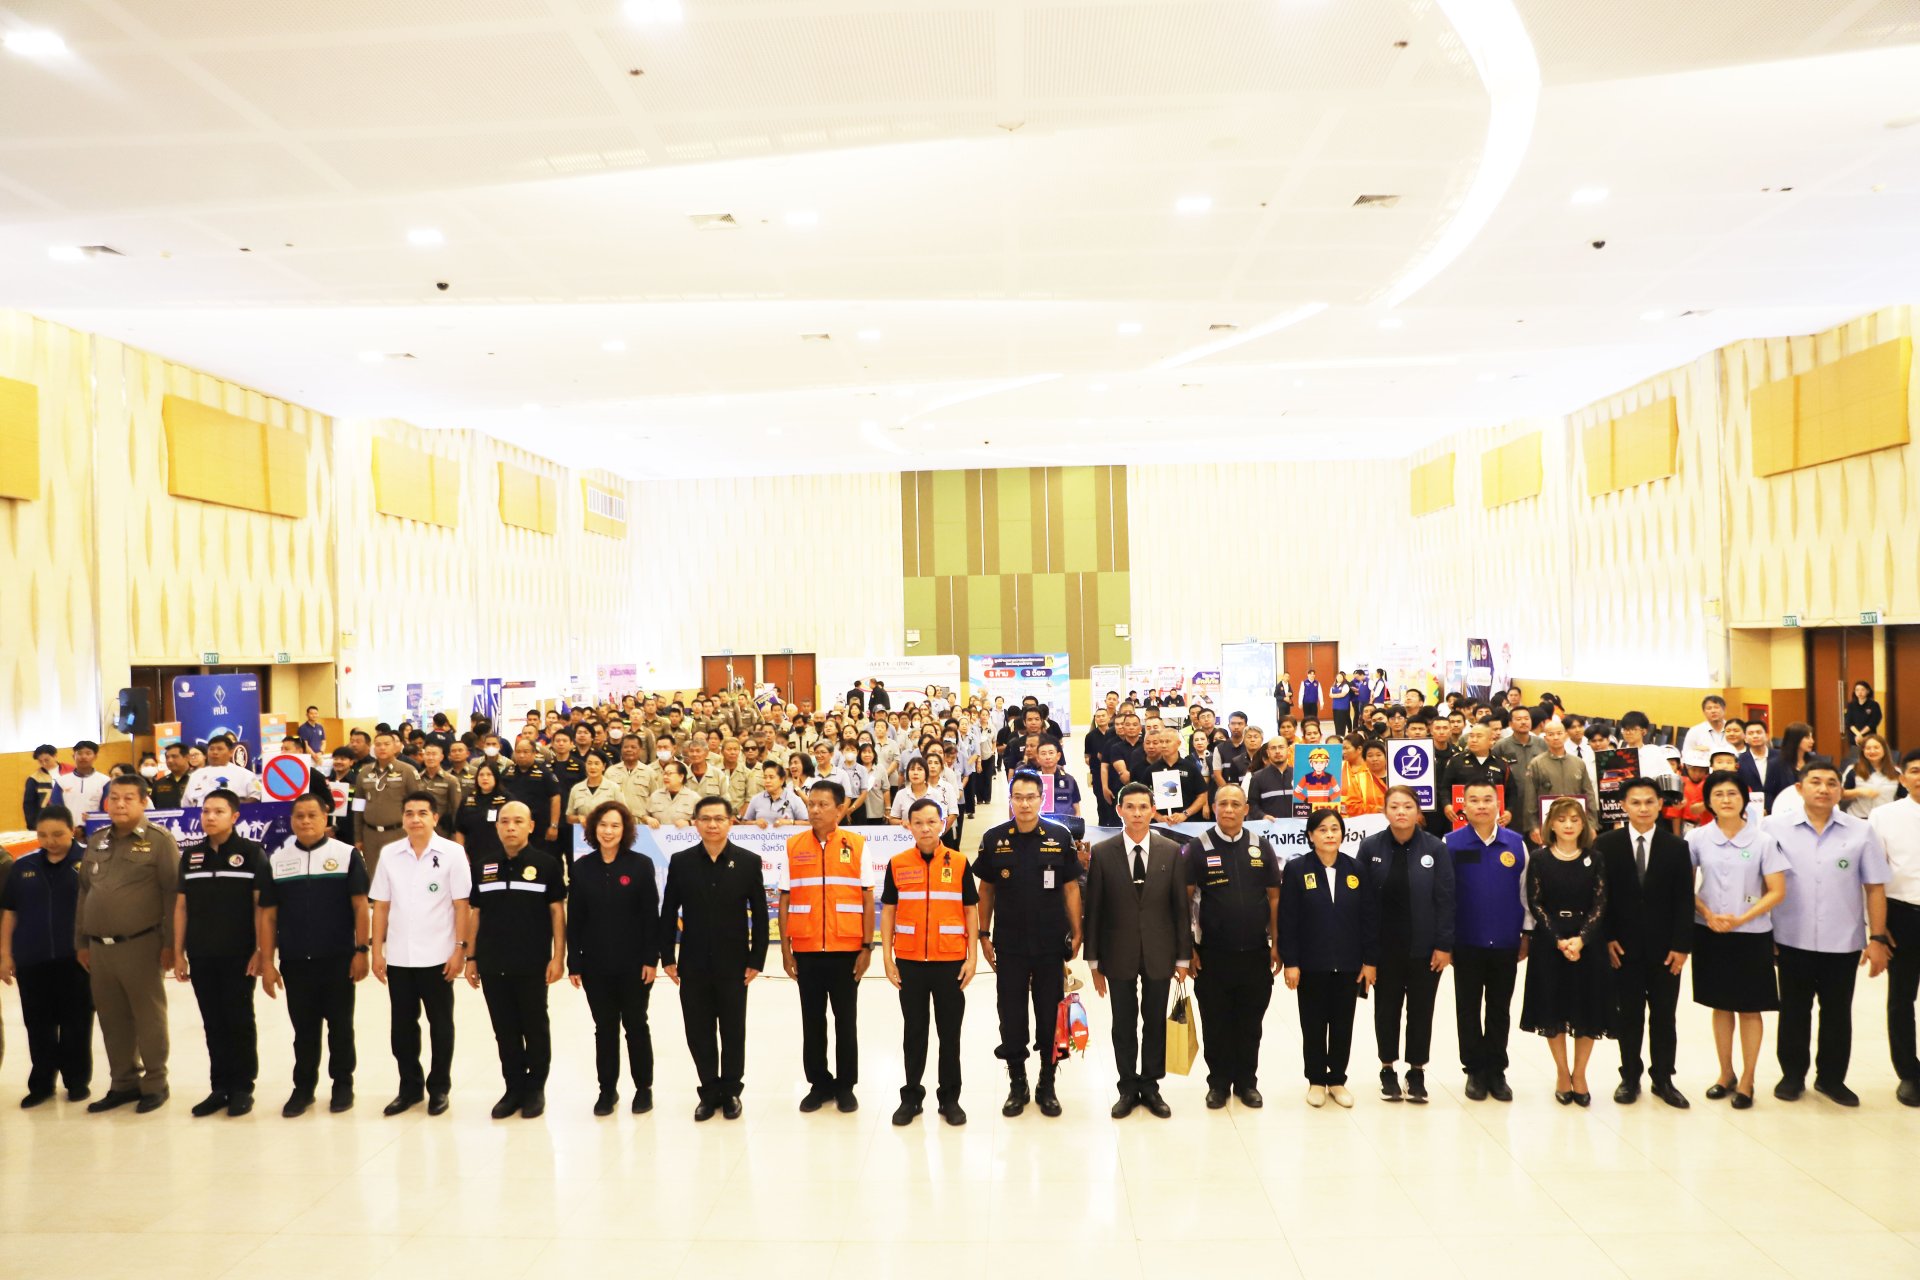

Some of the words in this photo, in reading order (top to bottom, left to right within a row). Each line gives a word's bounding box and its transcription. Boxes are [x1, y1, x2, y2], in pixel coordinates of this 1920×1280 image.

[1861, 613, 1877, 624] EXIT
[205, 654, 219, 663] EXIT
[1032, 669, 1046, 677] ต้อง
[37, 788, 53, 808] 7
[893, 833, 913, 842] 2569
